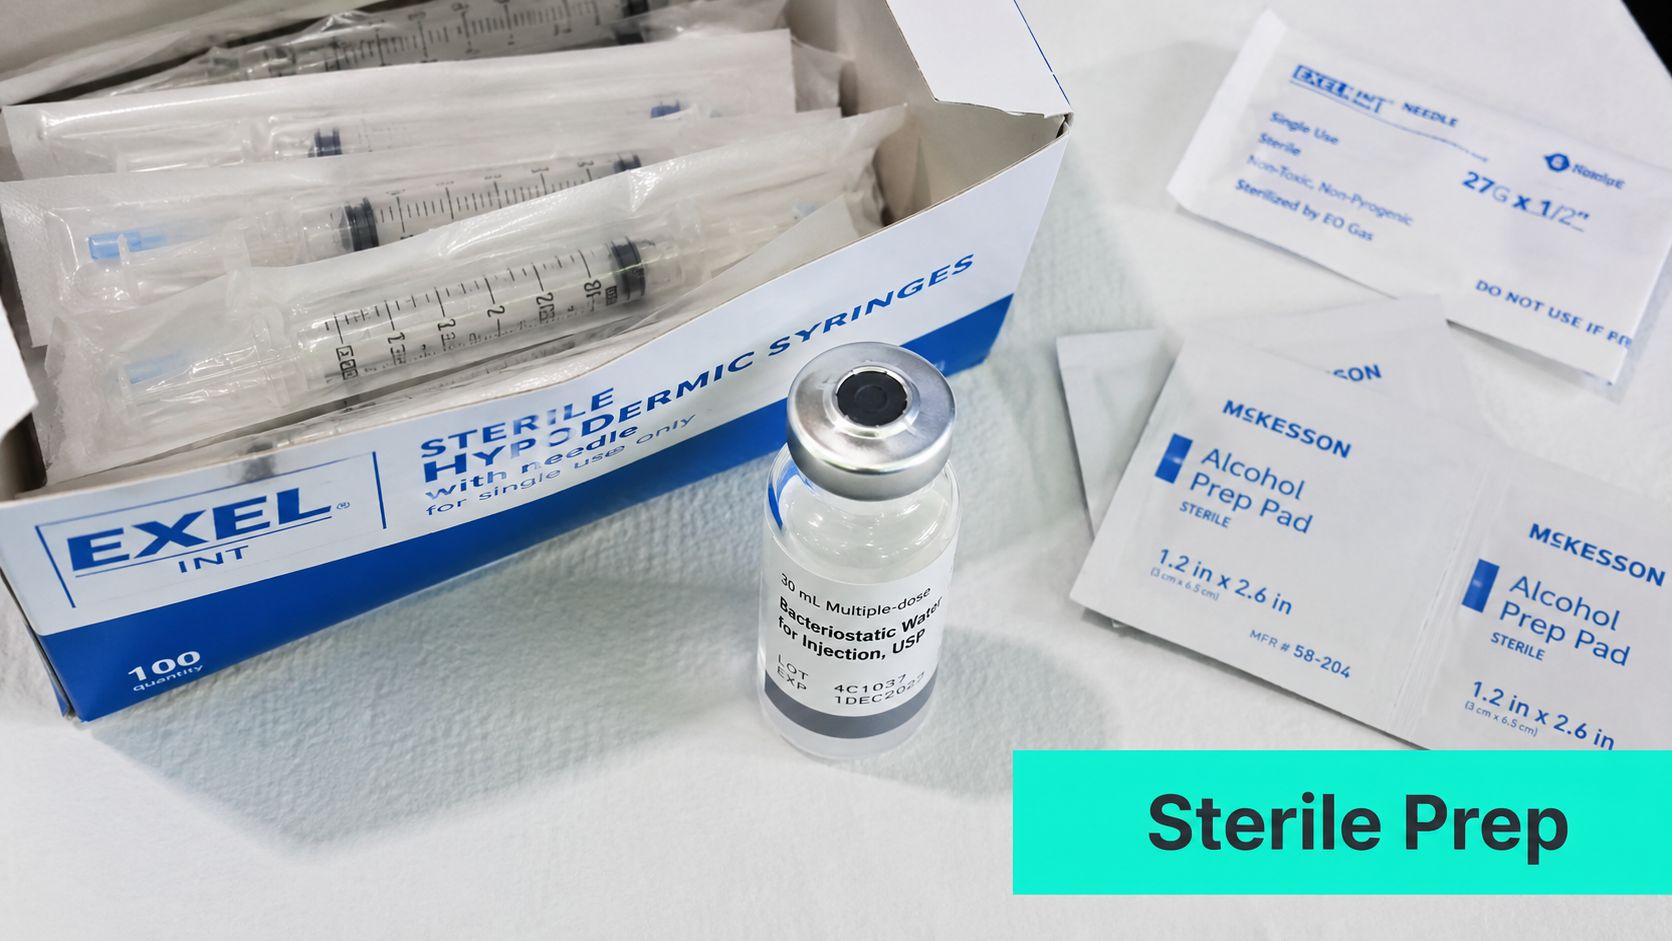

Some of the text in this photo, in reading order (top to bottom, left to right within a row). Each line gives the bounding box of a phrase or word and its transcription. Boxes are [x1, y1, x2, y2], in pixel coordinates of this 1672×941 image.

[1270, 111, 1339, 145] Single Use
[1402, 102, 1458, 127] NEEDLE
[1258, 132, 1301, 156] Sterile
[1236, 179, 1374, 241] Sterilized by EO Gas
[1247, 154, 1413, 226] Non-Toxic, Non-Pyrogenic
[1462, 171, 1511, 203] 27G
[1512, 195, 1531, 210] x
[1475, 280, 1502, 297] DO
[1505, 292, 1544, 312] NOT
[1548, 306, 1583, 328] USE
[1586, 322, 1604, 335] IF
[423, 253, 974, 483] HYPODERMIC SYRINGES
[420, 387, 614, 459] STERILE
[425, 425, 638, 500] with needle
[426, 414, 696, 516] for single use only
[1202, 448, 1306, 500] Alcohol
[1179, 500, 1231, 529] STERILE
[1190, 472, 1314, 534] Prep Pad
[179, 545, 249, 573] INT
[1159, 549, 1292, 615] 1.2 in x 2.6 in
[781, 573, 931, 618] 30 mL Multiple-dose
[1150, 567, 1220, 601] (3 cm x 6.5 cm)
[1509, 574, 1620, 631] Alcohol
[778, 615, 926, 661] for Injection, USP
[780, 596, 943, 642] Bacteriostatic Water
[1499, 601, 1631, 667] Prep Pad
[128, 651, 201, 681] 100
[1250, 629, 1351, 679] MFR # 58-204
[1490, 632, 1545, 661] STERILE
[133, 665, 204, 691] quantity
[777, 666, 807, 690] EXP
[778, 654, 906, 693] LOT 4C1037
[1464, 701, 1539, 737] (3 cm x 6.5 cm)
[1473, 681, 1615, 750] 1.2 in x 2.6 in
